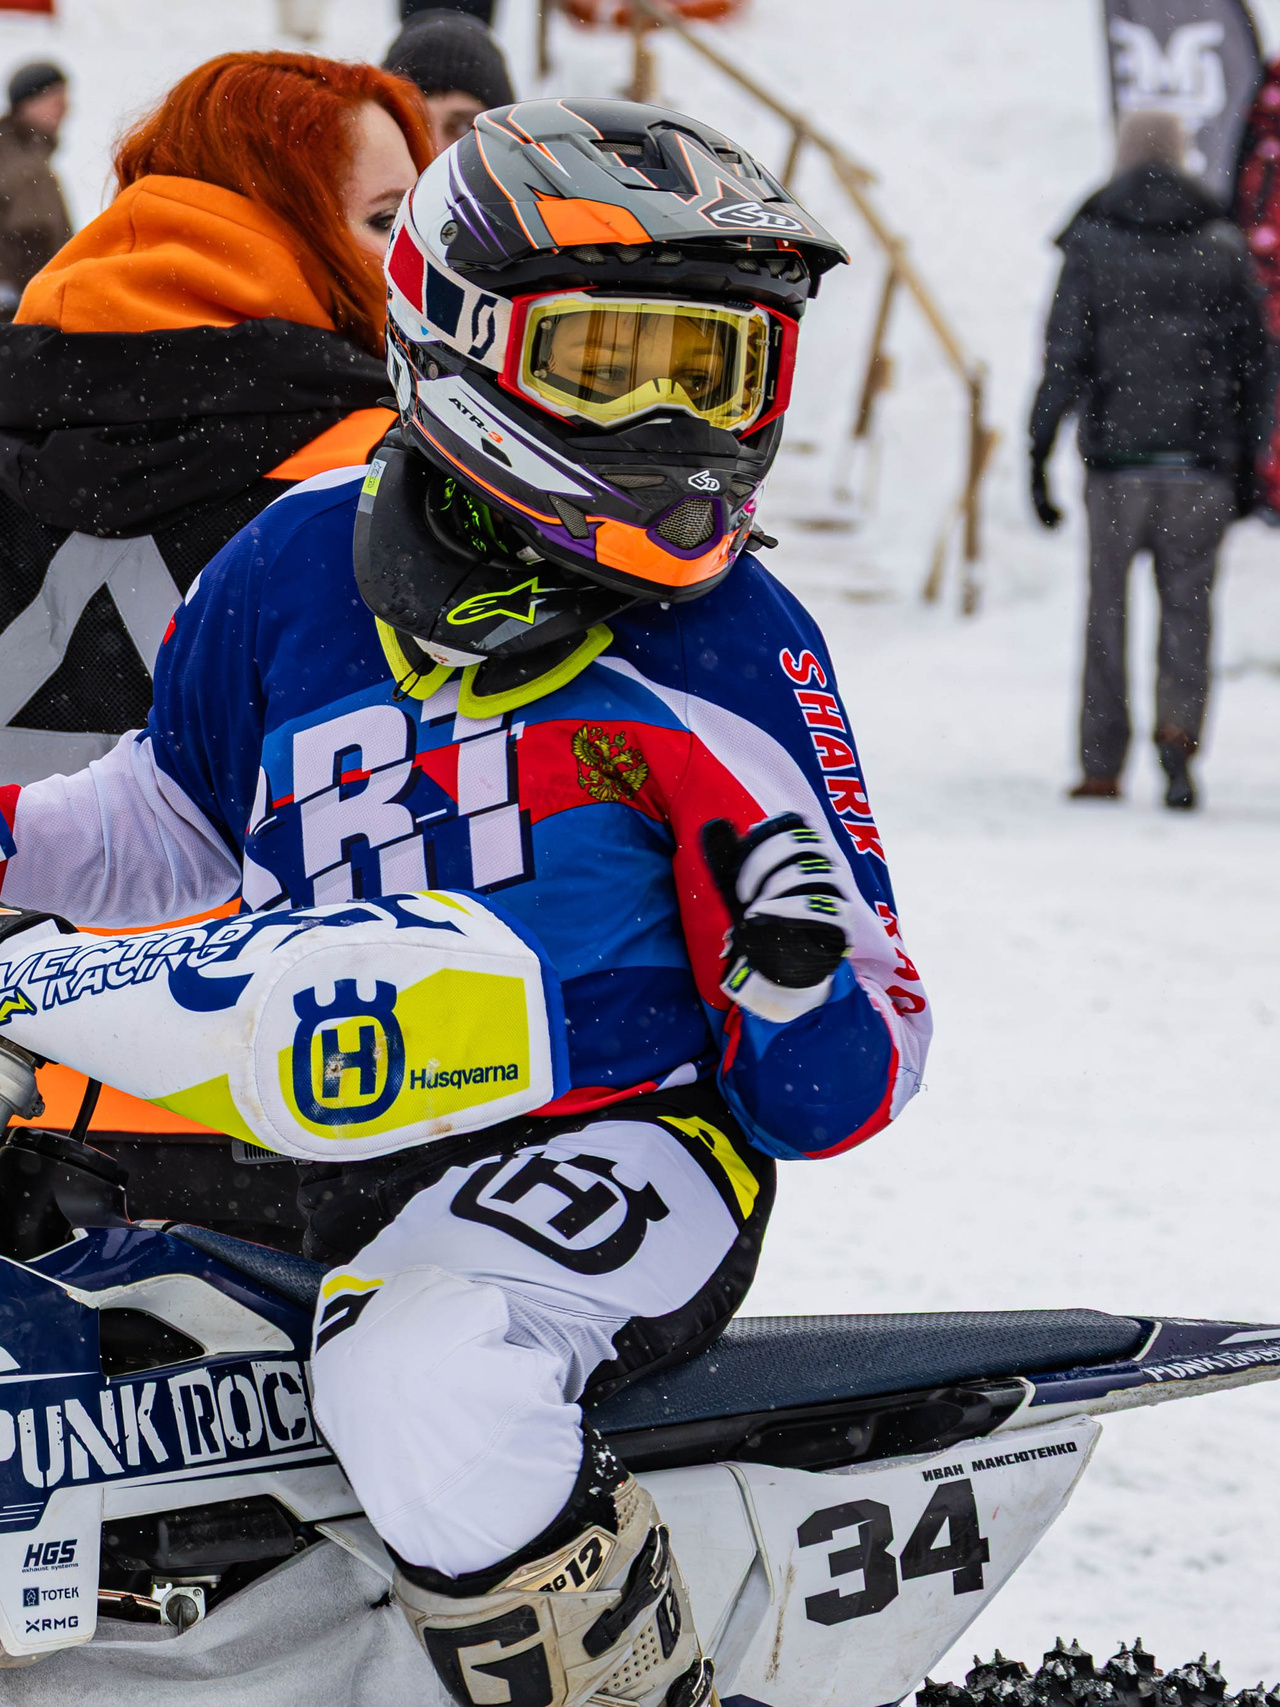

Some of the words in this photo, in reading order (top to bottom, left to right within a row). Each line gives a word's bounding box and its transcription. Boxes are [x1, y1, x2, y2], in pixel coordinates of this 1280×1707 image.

[448, 397, 504, 444] ATR-3
[779, 647, 888, 865] SHARK
[242, 680, 536, 916] RT
[42, 945, 232, 1010] RACING
[410, 1062, 519, 1092] Husqvarna
[169, 1360, 325, 1464] ROC
[922, 1463, 965, 1482] ИВАН
[971, 1441, 1078, 1472] МАКСЮТЕНКО
[23, 1539, 78, 1568] HGS
[51, 1563, 79, 1571] systems
[797, 1478, 990, 1626] 34
[41, 1586, 79, 1601] TOTEK
